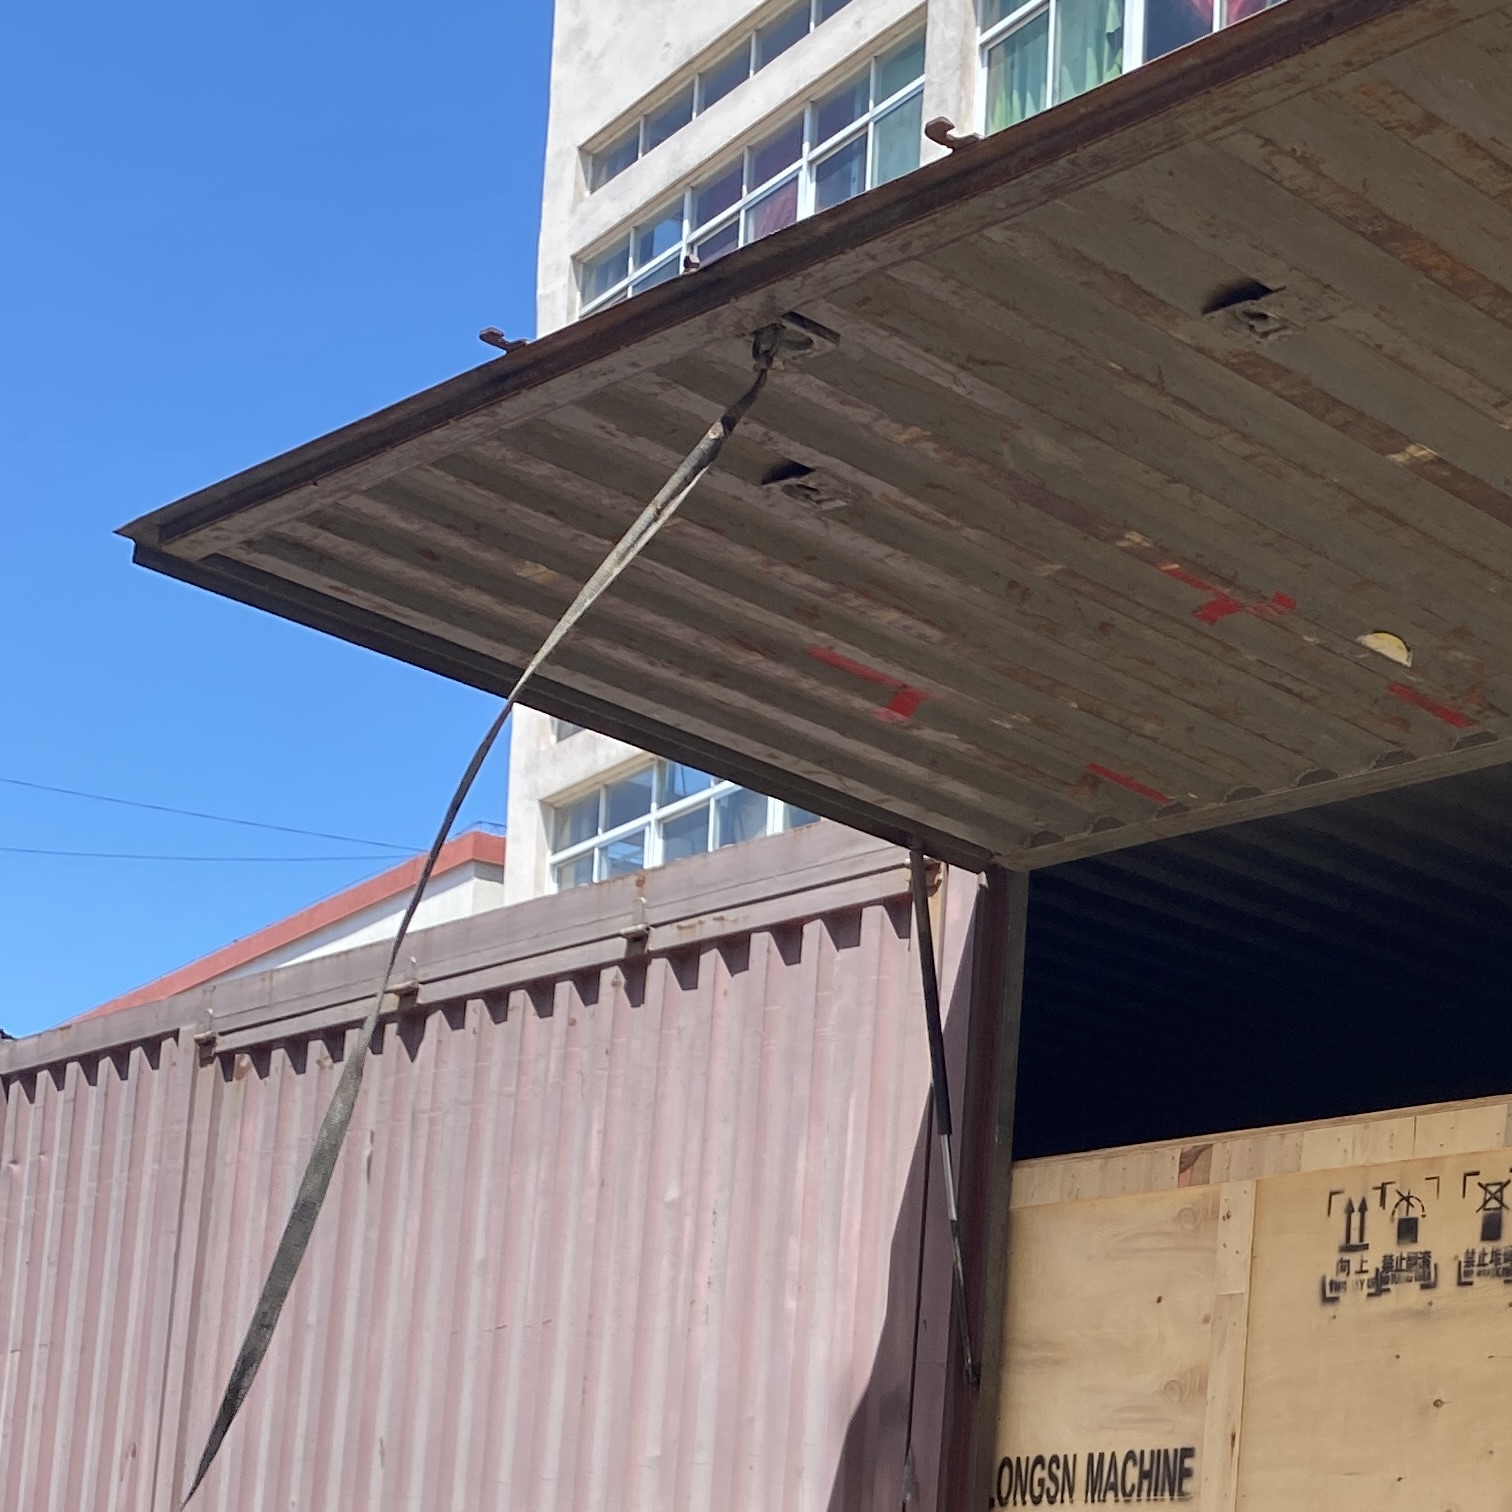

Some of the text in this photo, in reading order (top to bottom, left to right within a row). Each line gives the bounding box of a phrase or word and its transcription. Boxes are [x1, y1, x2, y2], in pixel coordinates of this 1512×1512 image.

[1336, 1256, 1369, 1278] 向上
[988, 1446, 1196, 1508] ONGSN MACHINE
